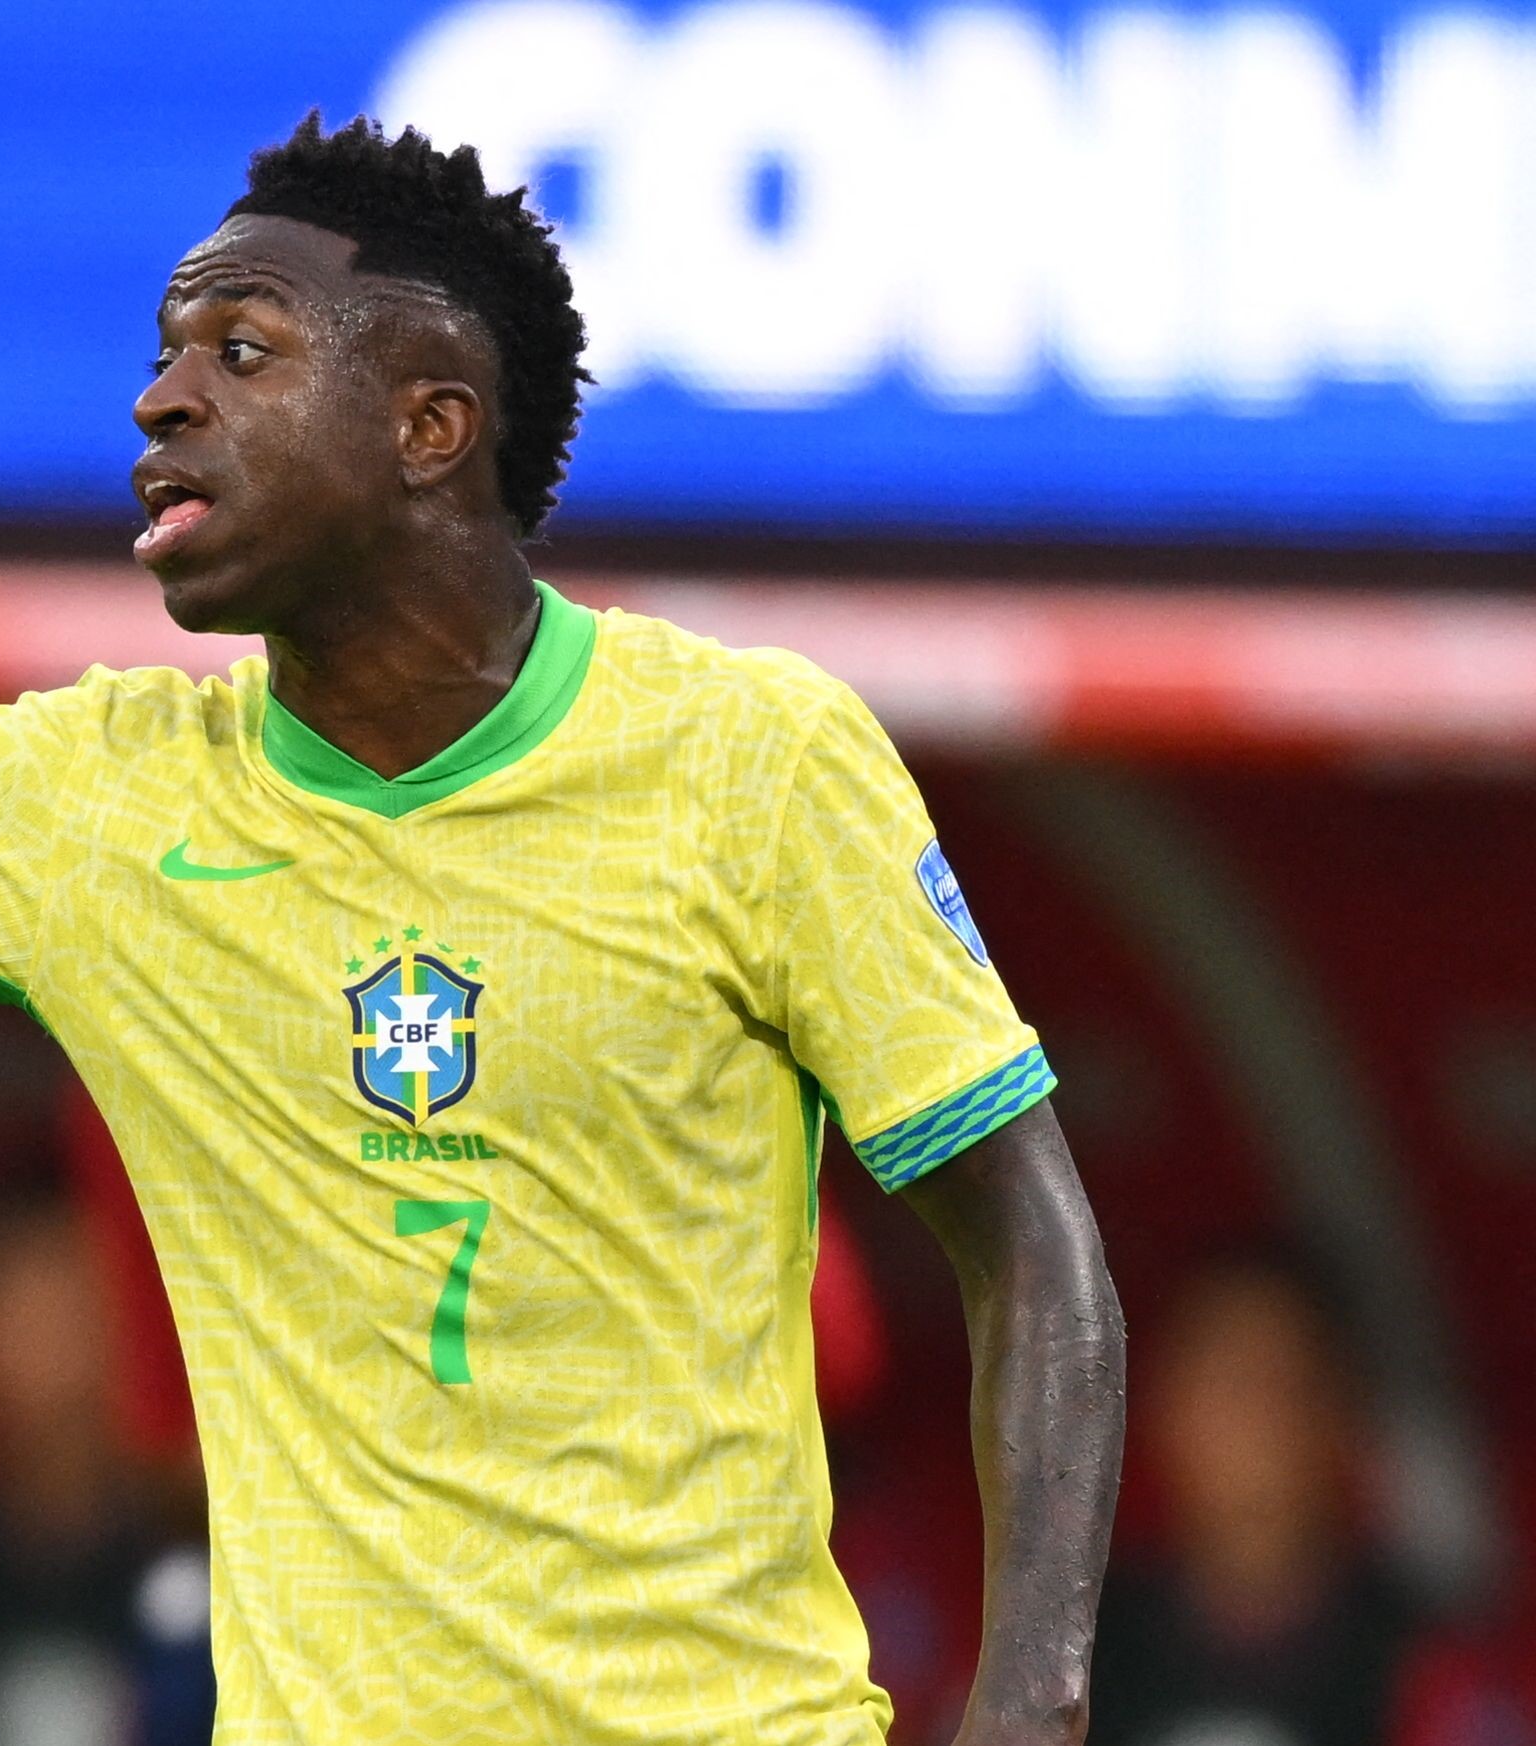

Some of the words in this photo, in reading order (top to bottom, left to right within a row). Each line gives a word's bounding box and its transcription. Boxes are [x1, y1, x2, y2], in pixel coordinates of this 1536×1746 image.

[390, 1023, 438, 1043] CBF
[361, 1132, 498, 1161] BRASIL
[395, 1200, 490, 1384] 7
